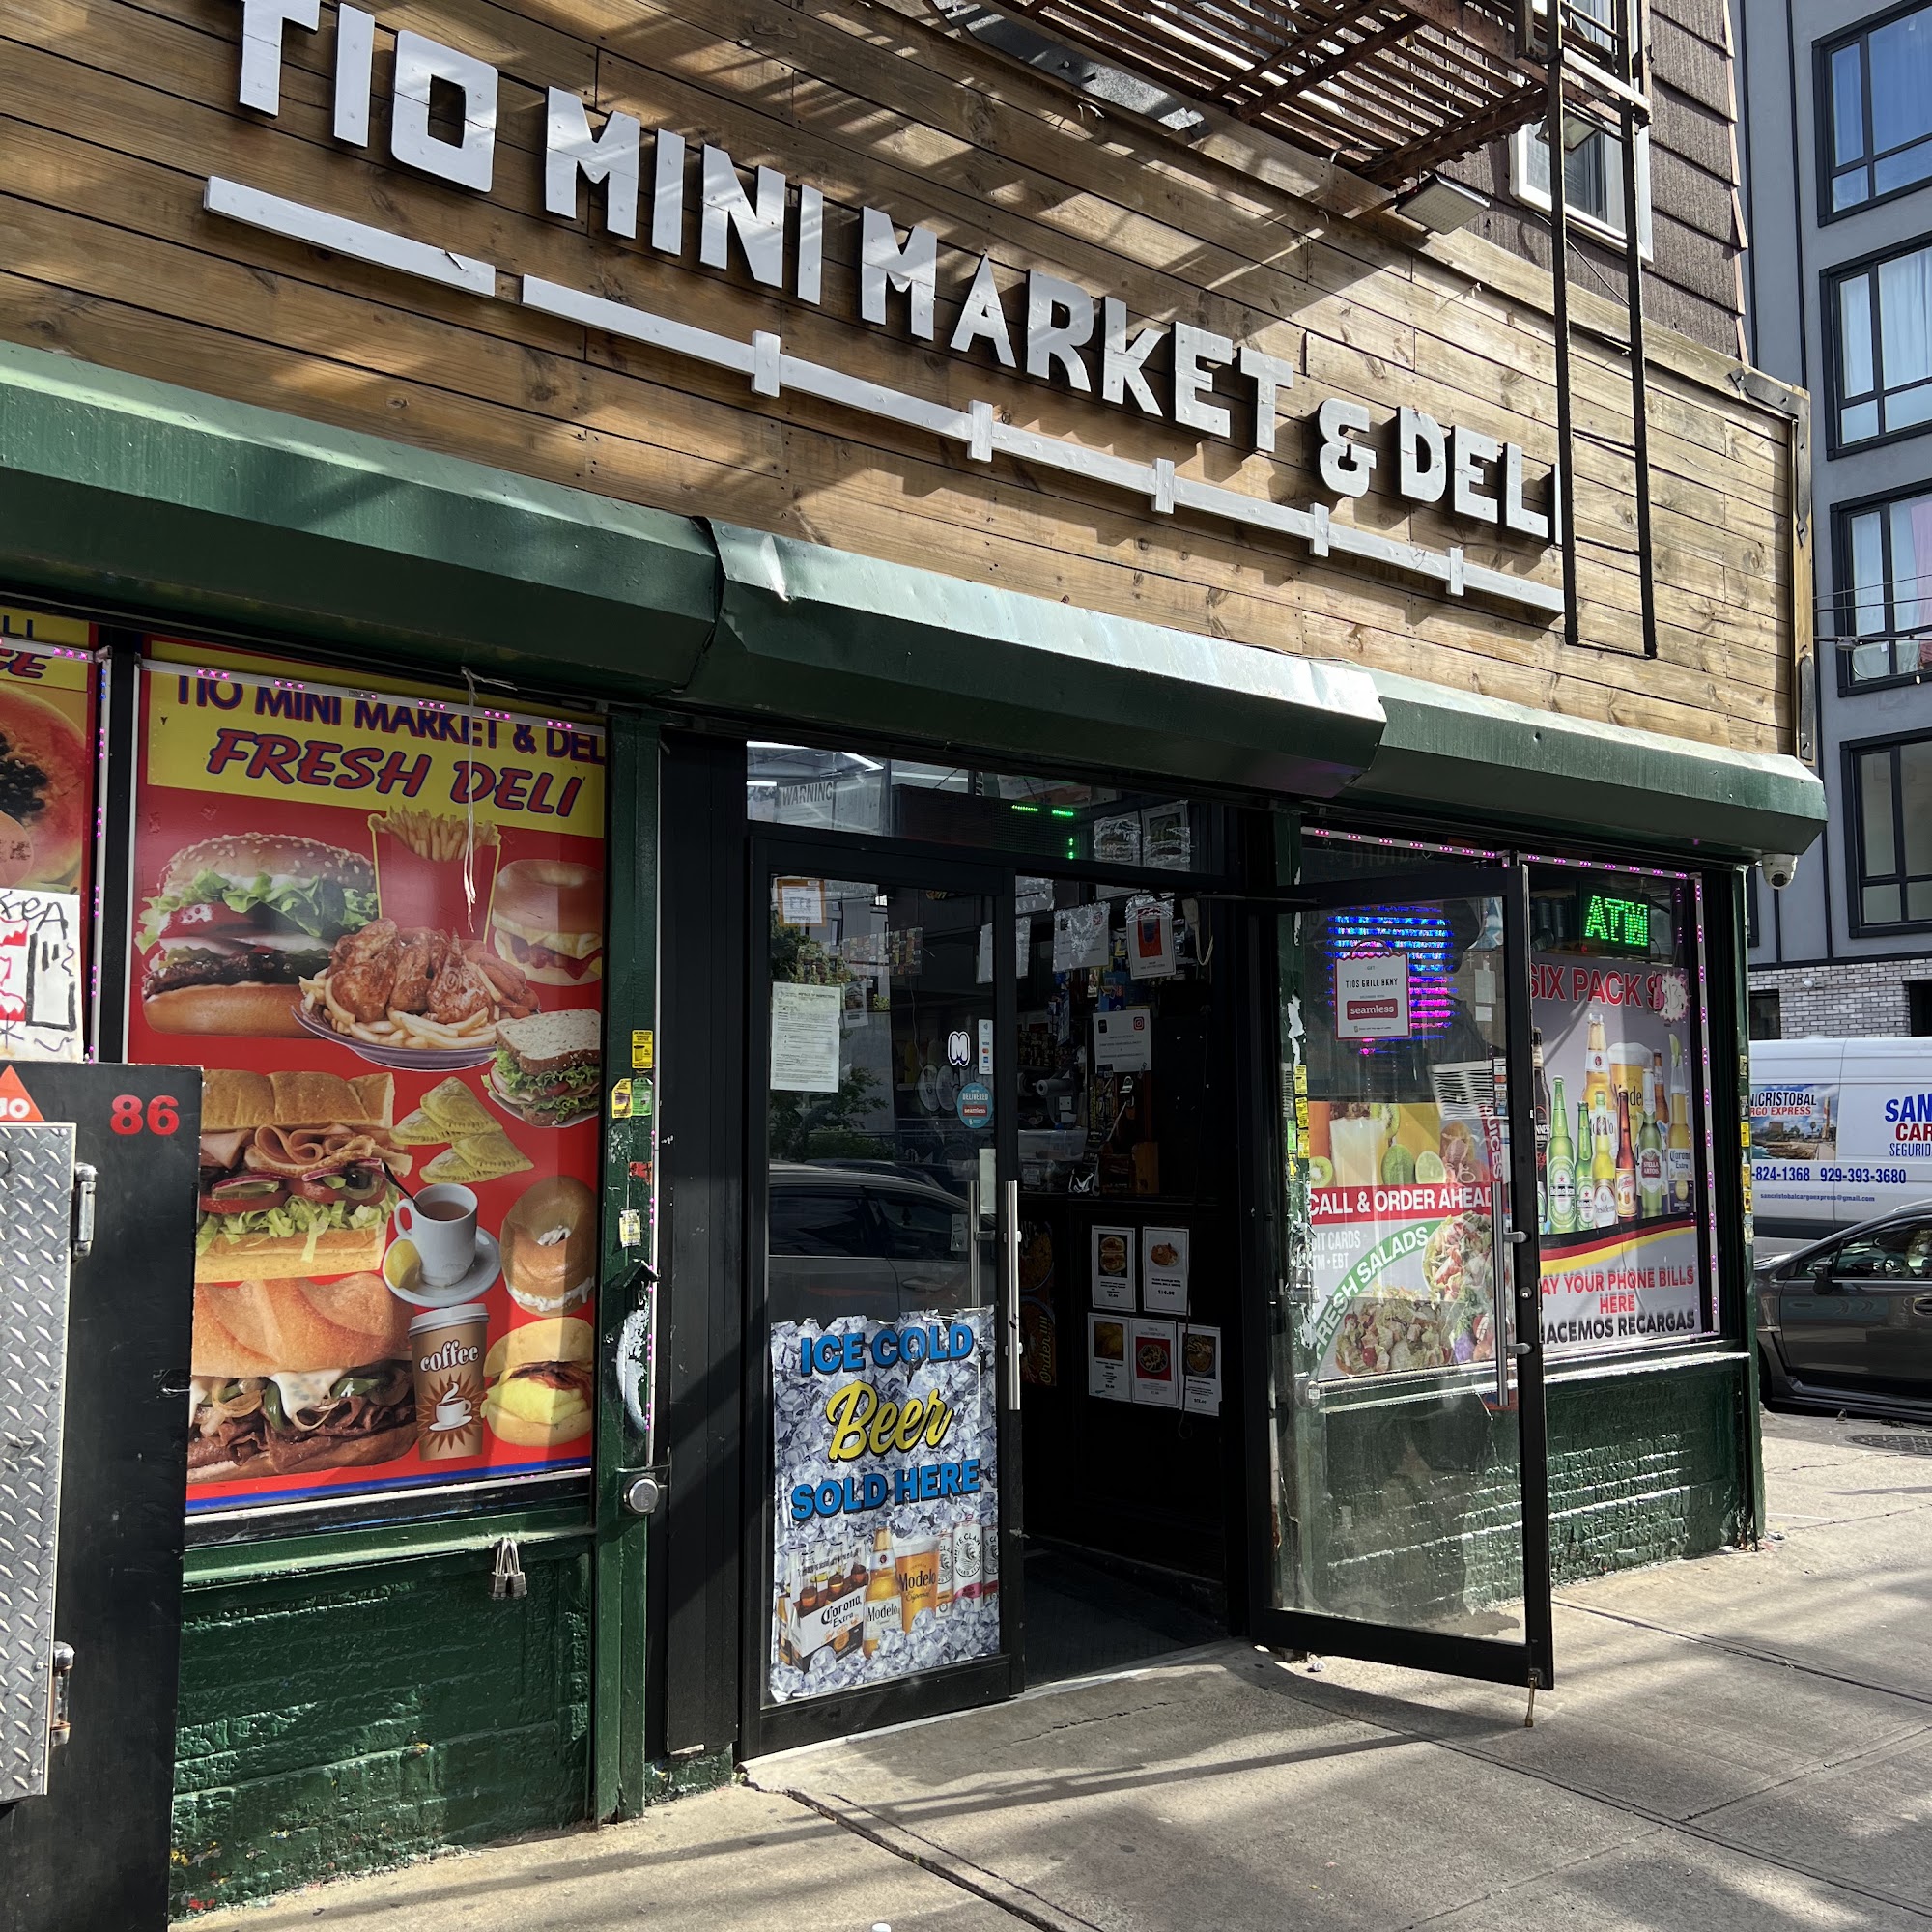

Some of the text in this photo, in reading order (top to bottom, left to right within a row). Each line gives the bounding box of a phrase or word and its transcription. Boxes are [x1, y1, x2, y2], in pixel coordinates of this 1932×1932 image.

[240, 0, 498, 192] TIO
[545, 85, 823, 305] MINI
[860, 206, 1293, 453] MARKET
[1318, 398, 1377, 497] &
[255, 686, 341, 725] MINI
[355, 699, 497, 748] MARKET
[513, 722, 536, 753] &
[547, 727, 605, 765] DEL
[207, 728, 583, 817] FRESH DELI
[782, 781, 833, 807] WARNING
[1585, 895, 1648, 947] ATM
[1361, 979, 1379, 987] GRILL
[1381, 978, 1398, 986] BKNY
[1530, 963, 1567, 1001] SIX
[1572, 967, 1643, 1008] PACK
[1350, 1005, 1395, 1015] seamless
[962, 1093, 989, 1101] DELIVERED
[1750, 1106, 1811, 1116] RGO EXPRESS
[1758, 1092, 1817, 1107] CRISTOBAL
[1885, 1093, 1932, 1122] SAN
[110, 1094, 180, 1135] 86
[1895, 1122, 1932, 1141] CAR
[1487, 1116, 1503, 1179] UICES
[1889, 1142, 1932, 1157] SEGURID
[1751, 1166, 1907, 1184] -824-1368 929-393-3680
[1308, 1192, 1353, 1217] CALL
[1357, 1190, 1371, 1214] &
[1374, 1188, 1436, 1212] ORDER
[1328, 1230, 1361, 1250] CARDS
[1313, 1252, 1349, 1270] TM EBT
[1357, 1226, 1430, 1284] SALADS
[1540, 1266, 1694, 1295] AY YOUR PHONE BILLS
[1600, 1293, 1635, 1314] HERE
[1542, 1310, 1695, 1344] ACEMOS RECARGAS
[419, 1339, 479, 1372] coffee
[800, 1324, 974, 1377] ICE COLD
[825, 1379, 954, 1463] Beer
[790, 1459, 981, 1521] SOLD HERE
[898, 1568, 937, 1593] Modelo
[821, 1594, 863, 1626] Corona
[832, 1612, 855, 1628] Extra
[867, 1603, 898, 1623] Modelo
